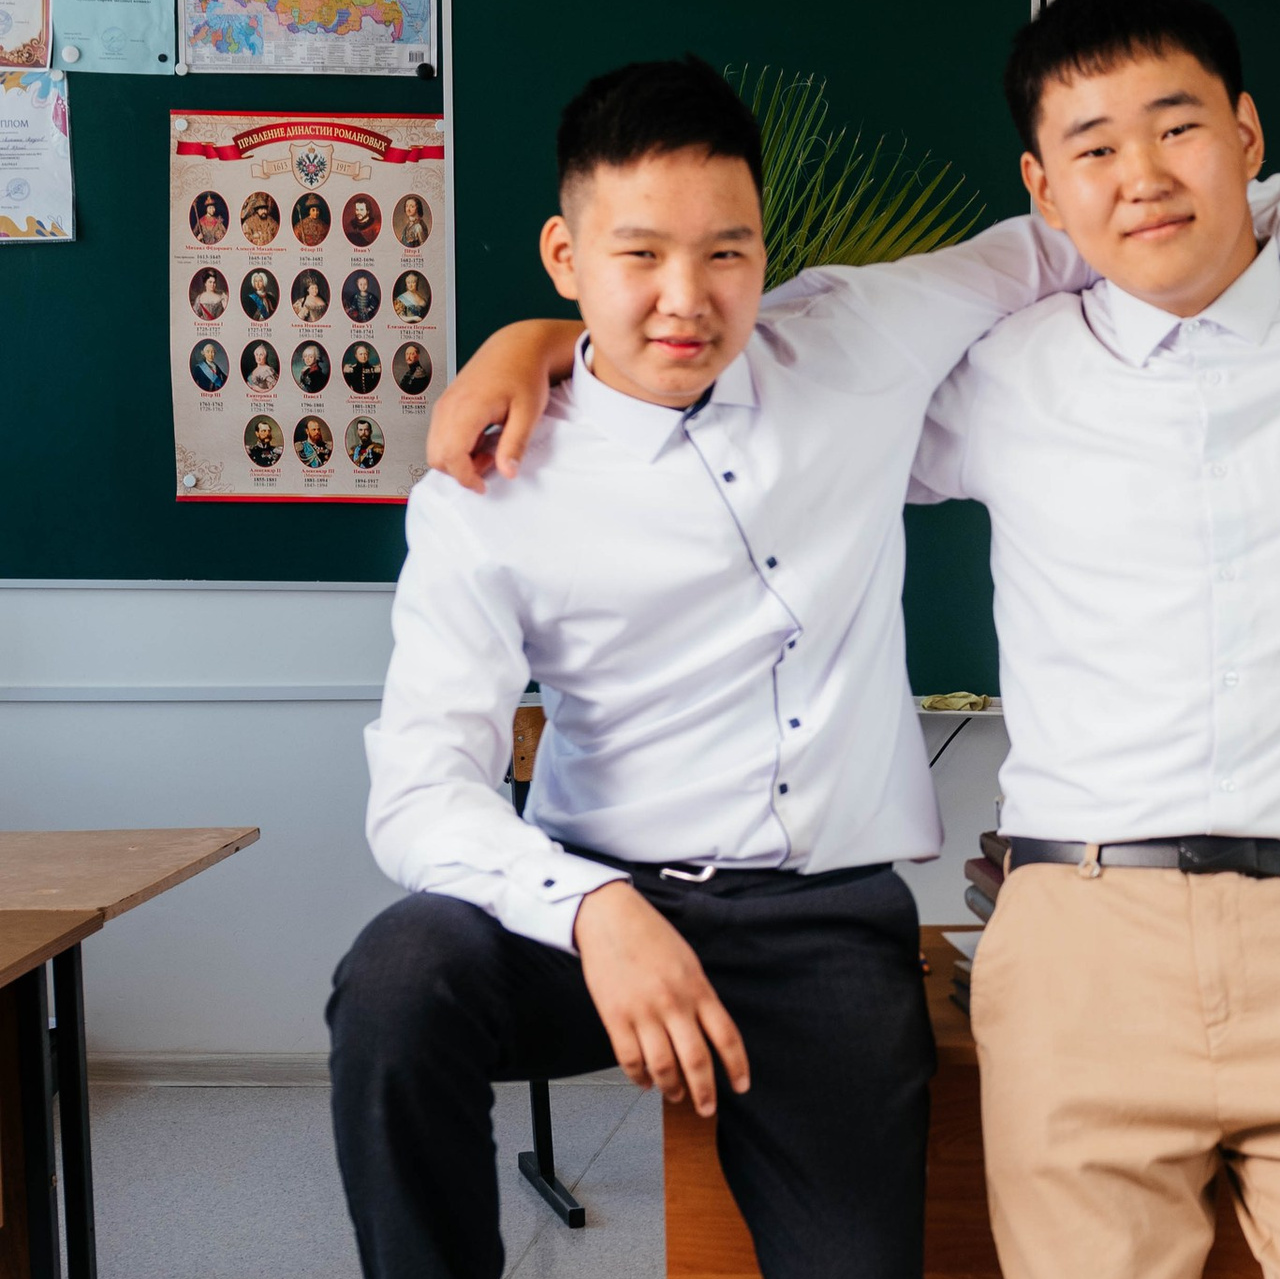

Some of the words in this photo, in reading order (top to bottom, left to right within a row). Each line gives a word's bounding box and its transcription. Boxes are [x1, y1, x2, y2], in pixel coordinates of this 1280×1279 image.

[0, 119, 29, 128] ПЛОМ
[237, 127, 285, 150] ПРАВЛЕНИЕ
[286, 125, 333, 138] ДИНАСТИИ
[334, 126, 387, 152] РОМАНОВЫХ
[273, 162, 288, 172] 1613
[336, 163, 352, 172] 1917
